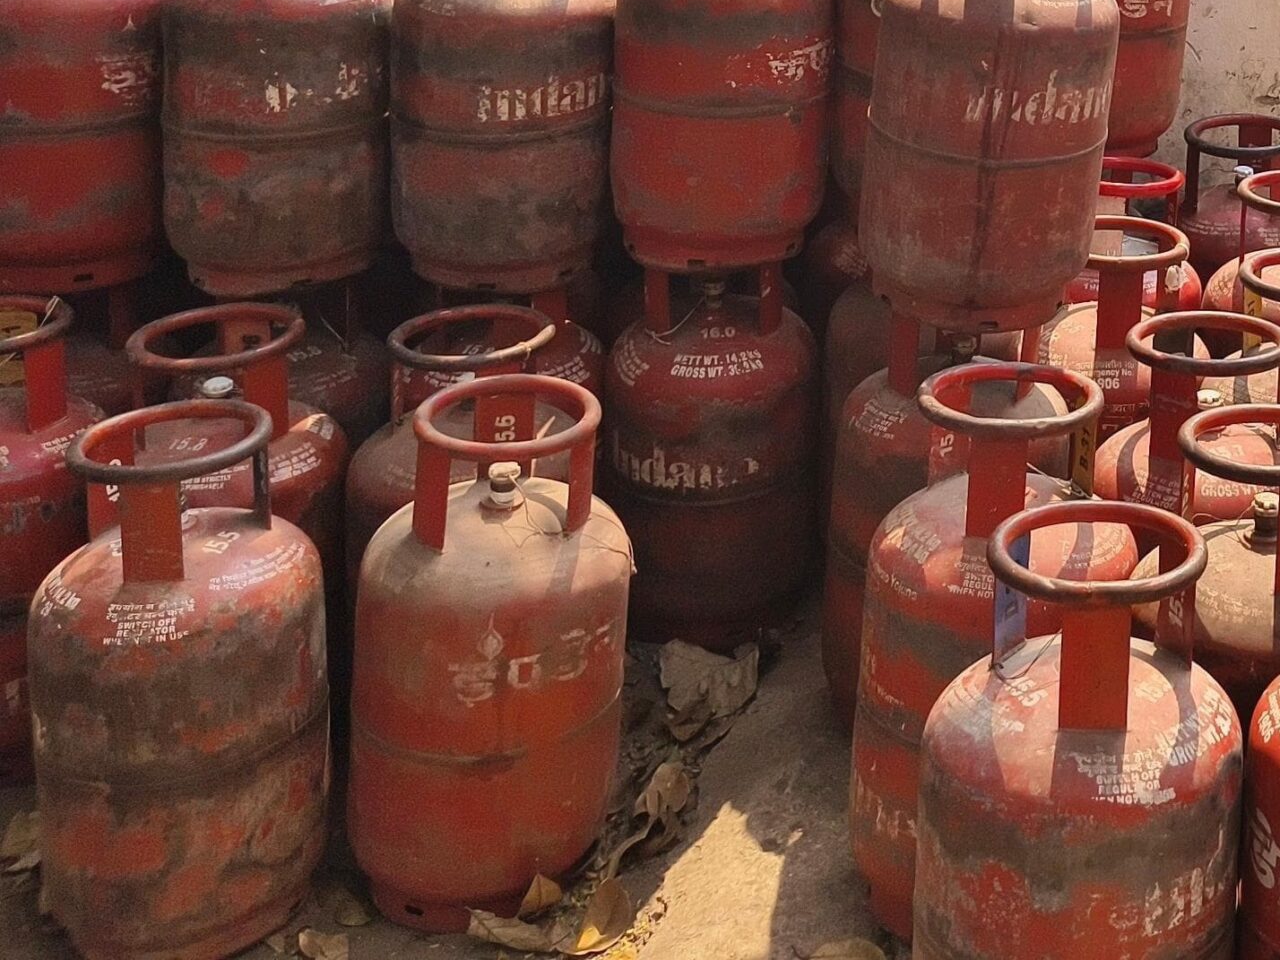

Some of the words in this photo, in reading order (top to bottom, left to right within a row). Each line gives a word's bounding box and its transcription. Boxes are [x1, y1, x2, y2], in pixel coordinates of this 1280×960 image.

[700, 326, 736, 339] 16.0
[671, 364, 706, 379] GROSS
[1097, 378, 1121, 390] 906
[202, 530, 241, 555] 15.5
[157, 617, 177, 628] OFF
